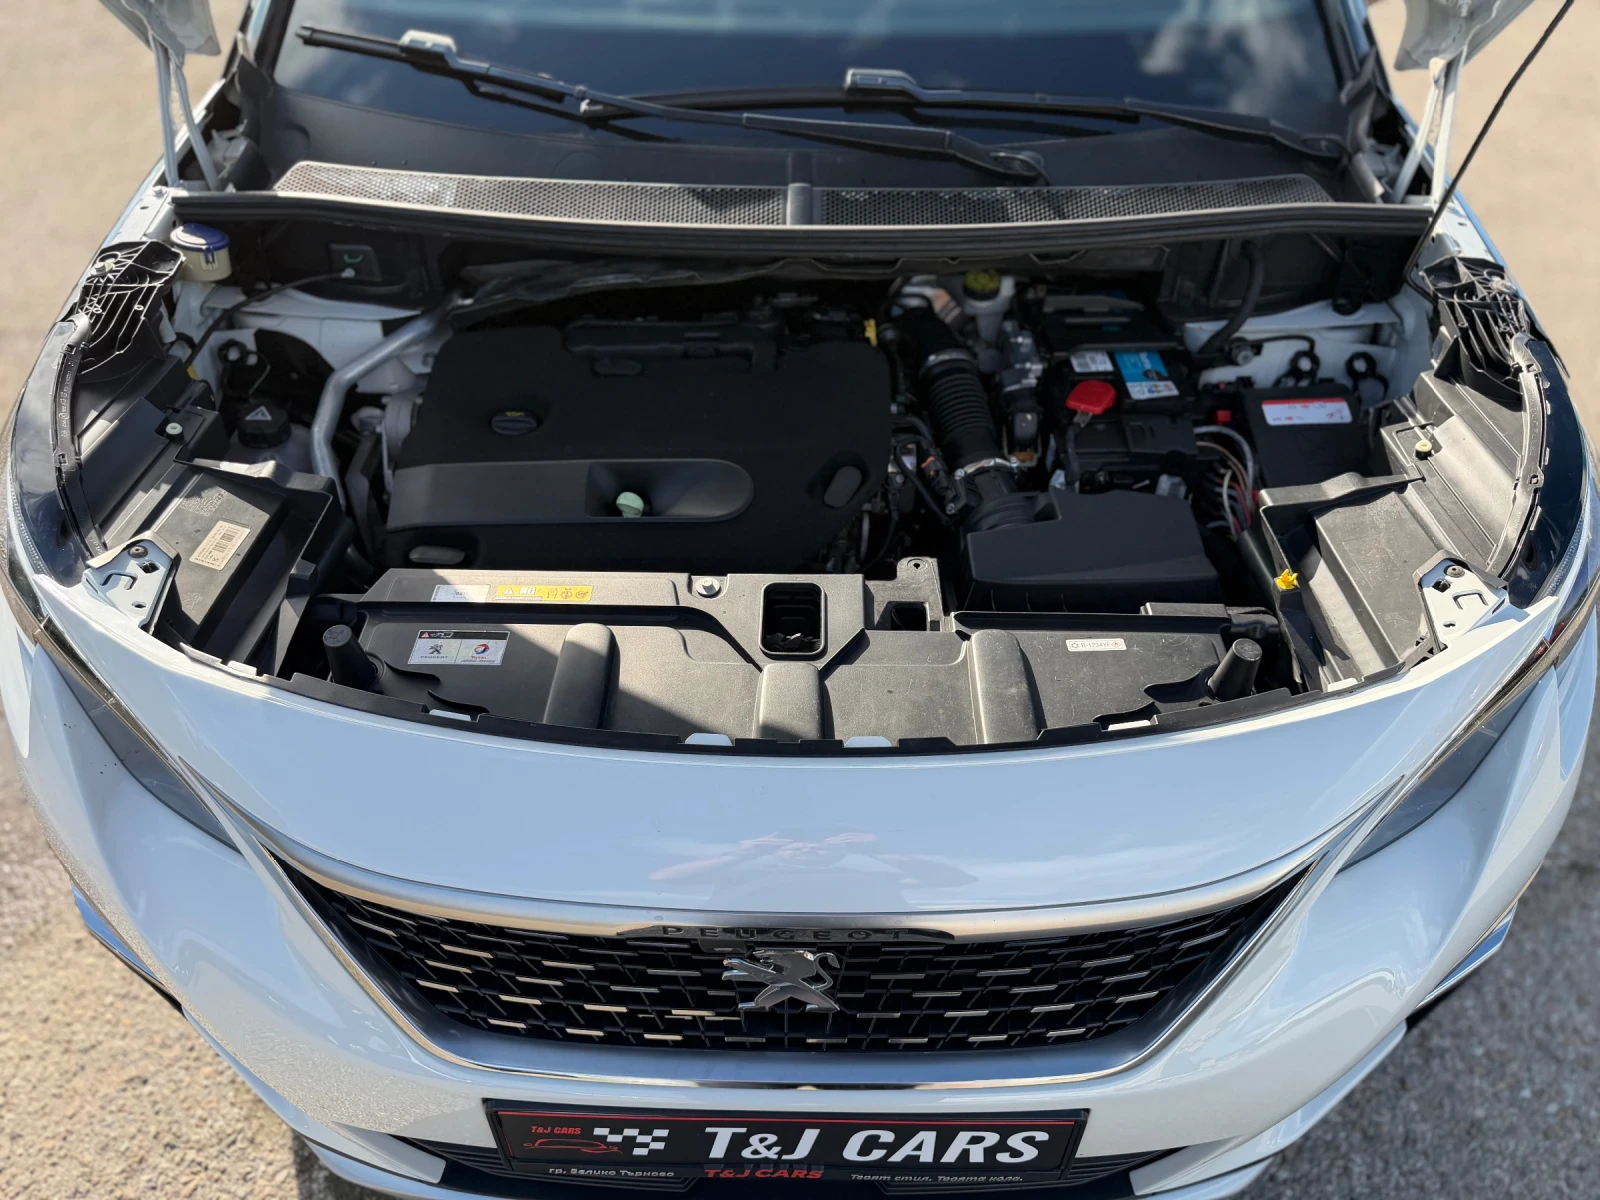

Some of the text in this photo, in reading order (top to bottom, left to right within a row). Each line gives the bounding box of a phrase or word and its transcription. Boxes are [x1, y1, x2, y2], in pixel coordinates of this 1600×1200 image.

[662, 926, 909, 941] PEUGEOT
[531, 1126, 582, 1135] T&J CARS
[704, 1127, 1050, 1164] T&J CARS
[619, 1169, 675, 1177] Търново
[704, 1169, 824, 1179] T&J CARS
